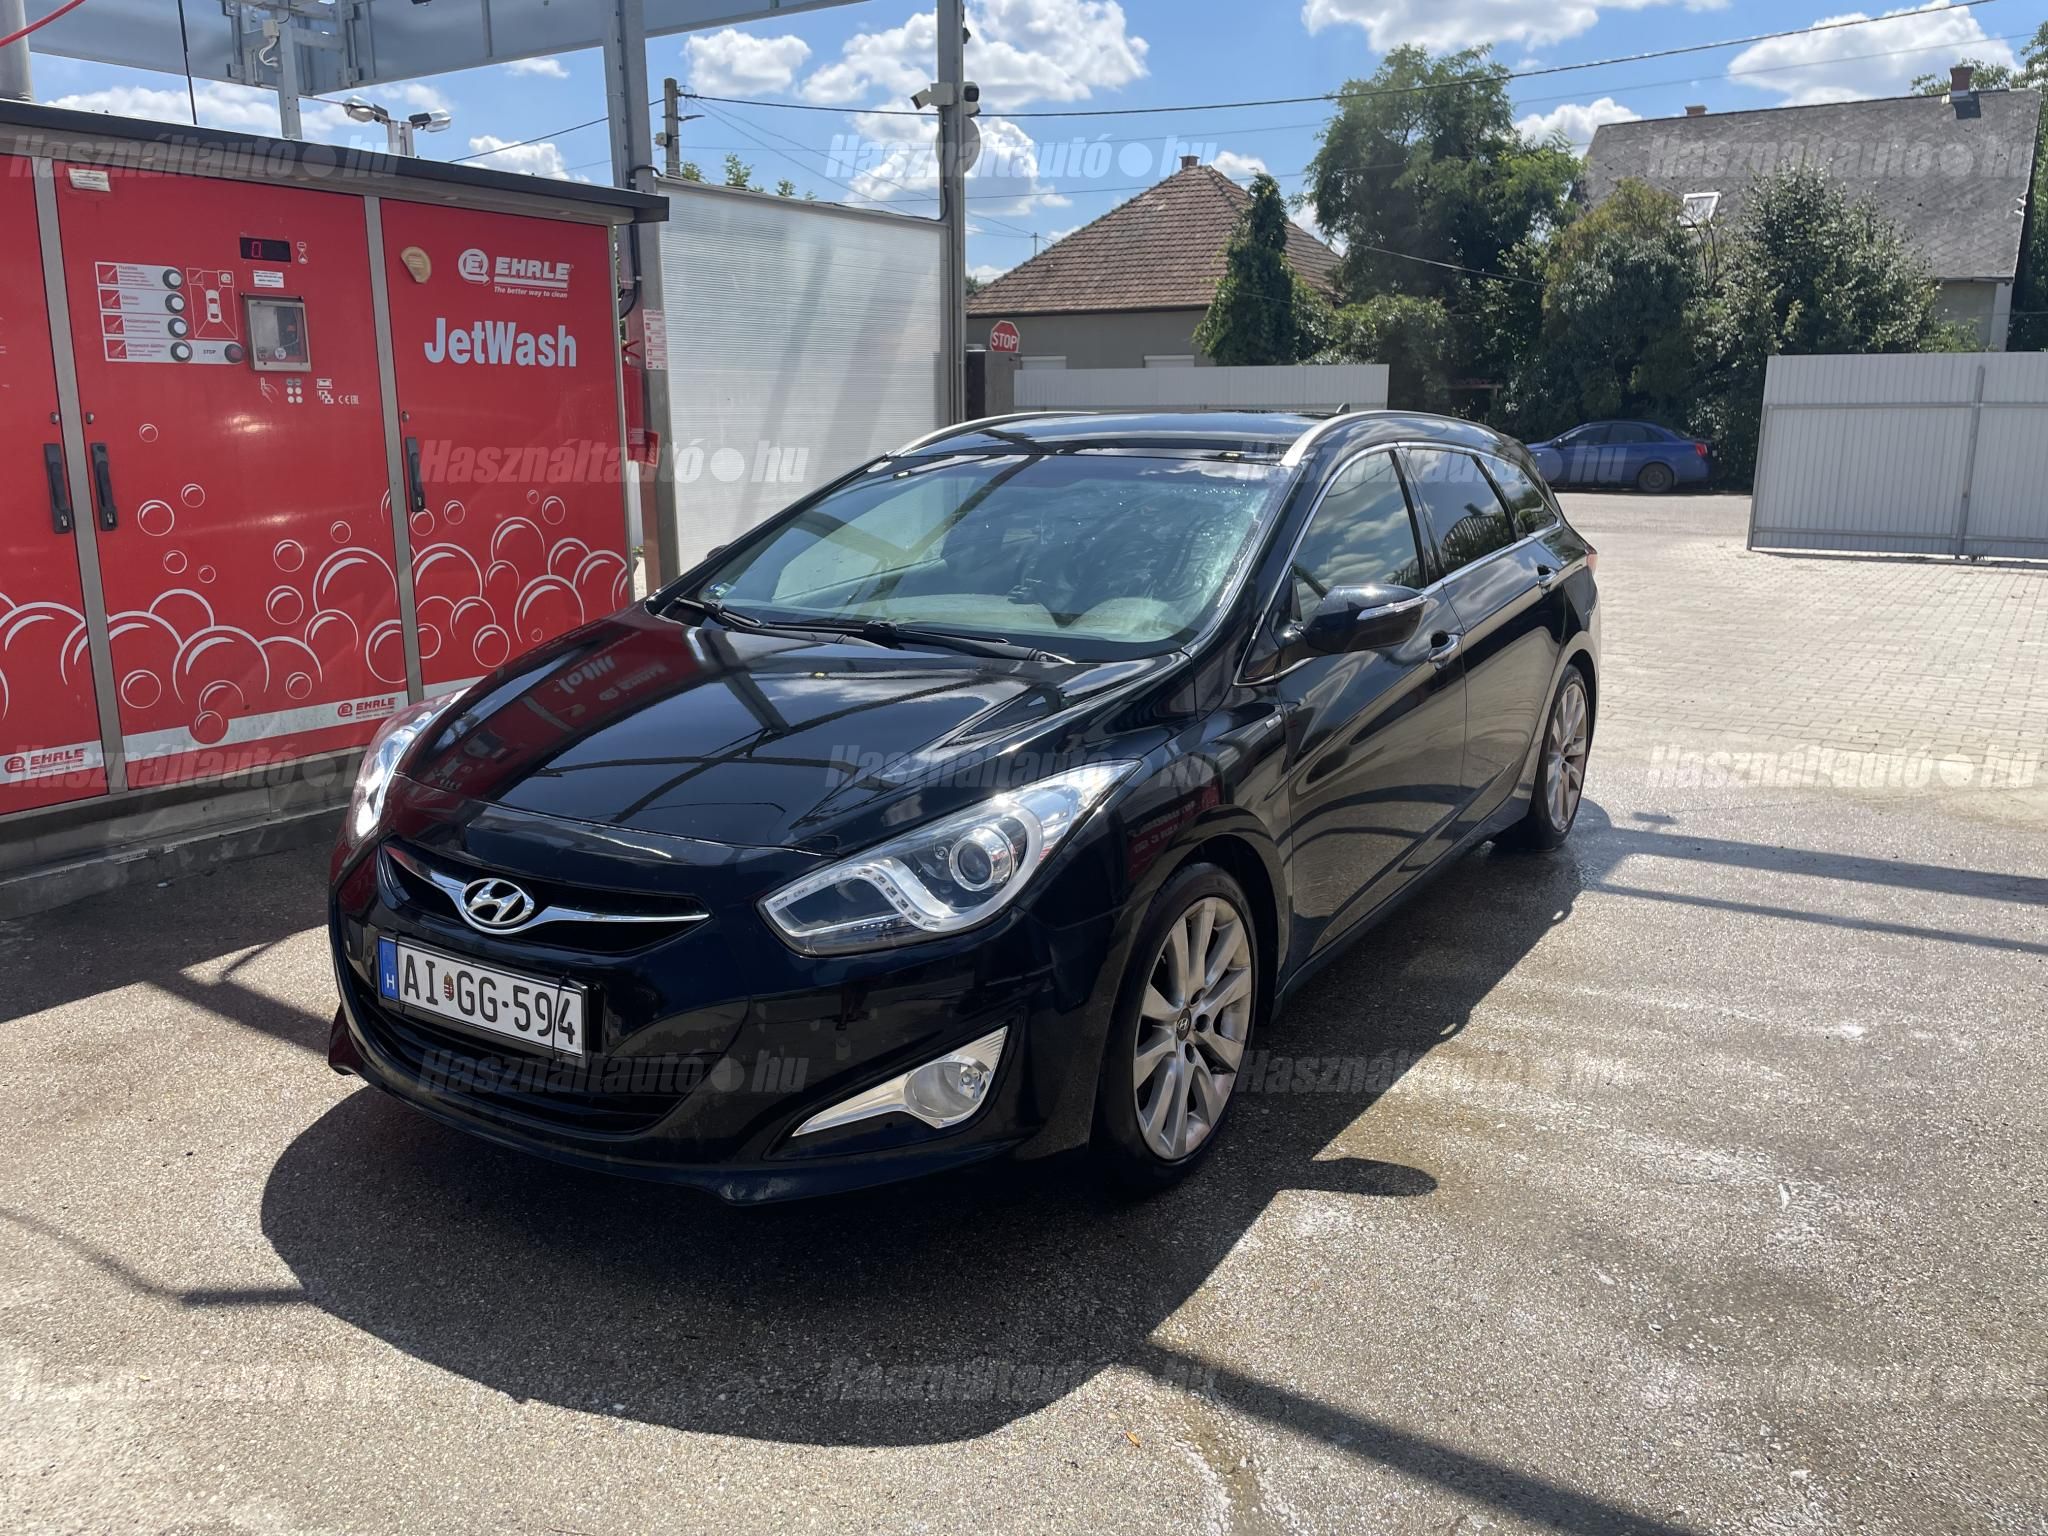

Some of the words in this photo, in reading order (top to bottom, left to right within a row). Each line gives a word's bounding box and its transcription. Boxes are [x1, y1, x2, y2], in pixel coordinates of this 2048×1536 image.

[495, 256, 570, 280] EHRLE
[494, 286, 506, 294] The
[507, 287, 527, 296] better
[529, 290, 542, 298] way
[424, 317, 577, 368] JetWash
[992, 331, 1018, 350] STOP
[356, 697, 396, 711] EHRLE
[30, 748, 86, 766] EHRLE
[386, 973, 395, 991] H
